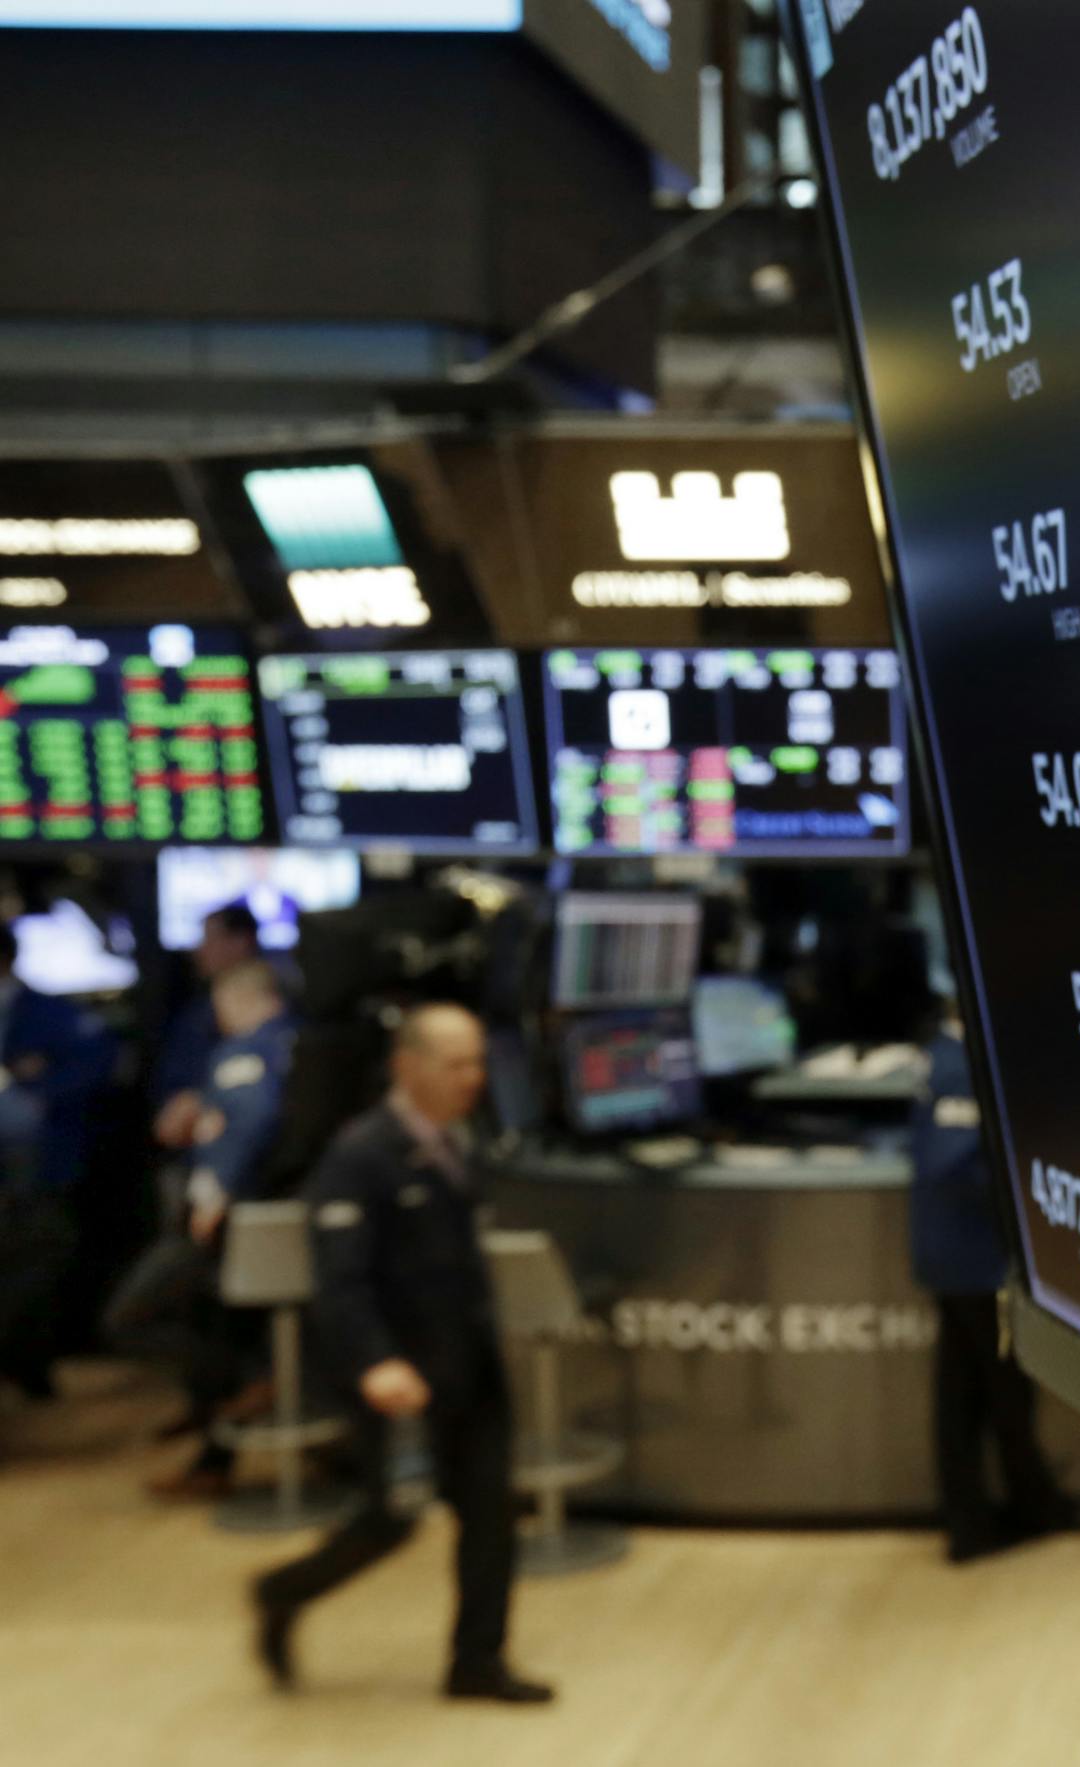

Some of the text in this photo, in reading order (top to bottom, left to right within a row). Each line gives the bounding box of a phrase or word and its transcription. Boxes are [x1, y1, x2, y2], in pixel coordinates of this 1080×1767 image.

[868, 6, 989, 180] 8,137,850
[952, 258, 1031, 372] 54.53
[992, 508, 1068, 602] 54.67
[612, 1299, 772, 1352] STOCK
